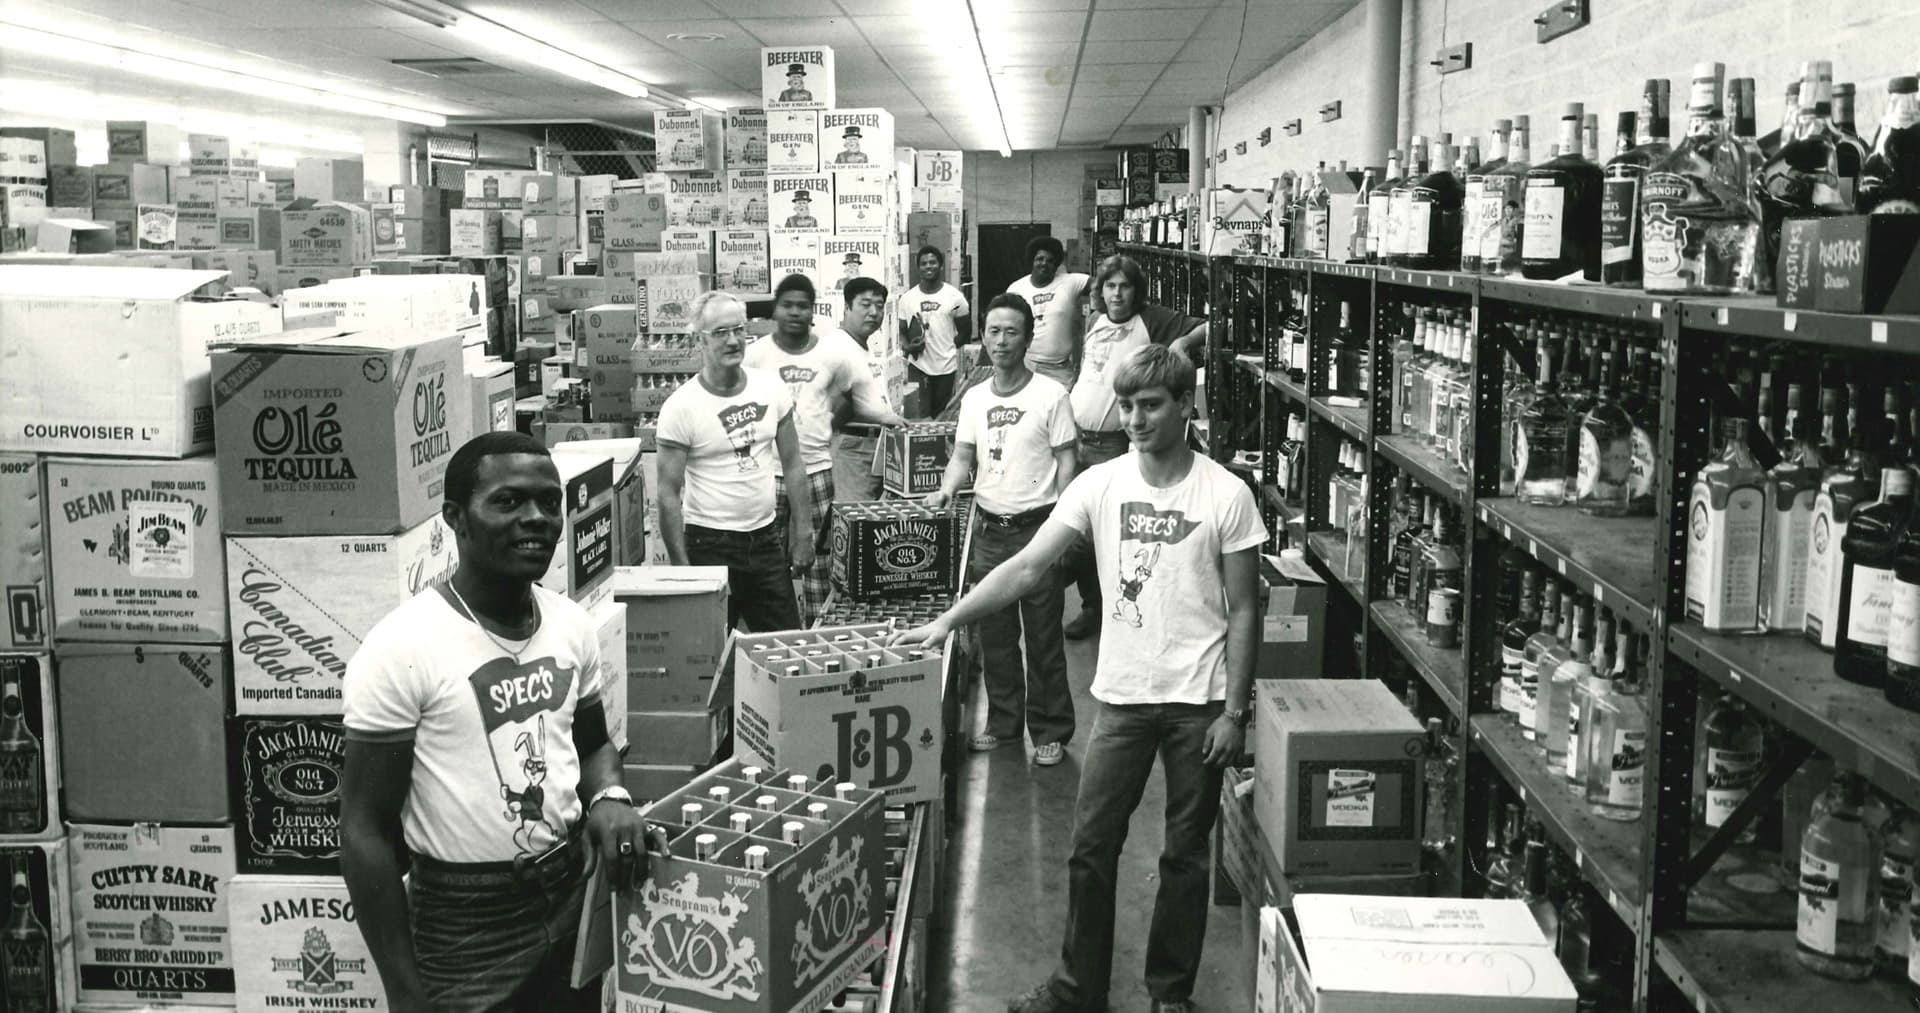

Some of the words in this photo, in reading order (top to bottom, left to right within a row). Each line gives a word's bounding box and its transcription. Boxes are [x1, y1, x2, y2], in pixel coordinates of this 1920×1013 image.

[768, 51, 824, 67] BEEFEATER
[660, 118, 700, 130] Dubonnet
[731, 116, 768, 128] Dubonne
[824, 114, 880, 130] BEEFEATER
[770, 133, 814, 144] BEEFEATER
[926, 161, 952, 182] J&B
[670, 179, 722, 194] Dubonnet
[732, 178, 768, 190] Dubonne
[773, 179, 829, 194] BEEFEATER
[839, 194, 882, 206] BEEFEATER
[1212, 215, 1264, 232] Bevnaps
[289, 240, 311, 248] SAFETY
[314, 240, 342, 248] MATCHES
[611, 238, 635, 248] GLASS
[666, 240, 706, 250] Dubonnet
[721, 240, 763, 252] Dubonnet
[824, 241, 880, 256] BEEFEATER
[773, 258, 817, 270] BEEFEATER
[611, 294, 634, 304] GLASS
[639, 286, 648, 328] GENUINO
[783, 368, 814, 382] SPEC'S
[263, 388, 343, 400] IMPORTED
[413, 372, 446, 438] Olé
[726, 404, 757, 428] SPEC'S
[990, 408, 1020, 424] SPEC'S
[24, 424, 134, 440] COURVOISIER
[253, 402, 344, 456] Olé
[410, 430, 452, 468] TEQUILA
[244, 458, 358, 482] TEQUILA
[60, 478, 68, 488] 12
[151, 480, 176, 490] ROUND
[177, 481, 206, 491] QUARTS
[913, 472, 938, 487] WILD
[263, 482, 296, 493] MADE
[298, 482, 312, 492] IN
[313, 482, 356, 493] MEXICO
[62, 490, 116, 523] BEAM
[137, 516, 157, 534] JIM
[158, 512, 186, 536] BEAM
[1128, 514, 1178, 536] SPEC'S
[576, 526, 596, 554] Johnnie
[594, 517, 612, 539] Walker
[874, 523, 899, 546] JACK
[899, 520, 939, 542] DANIEL'S
[341, 544, 350, 552] 12
[354, 544, 387, 552] QUARTS
[582, 548, 595, 566] BLACK
[595, 540, 608, 559] LABEL
[898, 548, 915, 557] Old
[896, 556, 917, 564] No.7
[874, 572, 908, 584] TENNESSEE
[910, 571, 938, 580] WHISKEY
[74, 588, 98, 597] JAMES
[113, 588, 136, 598] BEAM
[139, 588, 182, 598] DISTILLING
[186, 590, 200, 599] CO.
[12, 592, 38, 641] Q
[152, 610, 195, 618] KENTUCKY
[78, 622, 106, 631] Famous
[111, 622, 122, 632] for
[126, 622, 154, 632] Quality
[158, 622, 178, 632] Since
[196, 653, 212, 668] 12
[178, 652, 214, 688] QUARTS
[242, 686, 293, 702] Imported
[296, 686, 342, 700] Canadia
[490, 666, 554, 714] SPEC'S
[258, 730, 296, 760] JACK
[296, 723, 346, 755] DANIE
[816, 705, 913, 789] J&B
[286, 750, 304, 758] OLD
[310, 748, 330, 758] TIME
[296, 768, 320, 780] Old
[295, 780, 324, 791] No.7
[1332, 804, 1368, 812] VODKA
[272, 806, 340, 828] Tenness
[84, 832, 118, 841] PRODUCE
[270, 834, 341, 848] WHISK
[83, 842, 128, 852] SCOTLAND
[190, 844, 223, 854] QUARTS
[816, 856, 850, 887] Seagram's
[91, 864, 158, 890] CUTTY
[162, 865, 220, 895] SARK
[726, 875, 733, 884] 12
[734, 876, 760, 889] QUARTS
[93, 894, 150, 911] SCOTCH
[152, 896, 218, 913] WHISKY
[661, 893, 718, 916] Seagram's
[260, 897, 356, 926] JAMESO
[818, 893, 850, 942] VO
[95, 948, 132, 963] BERRY
[170, 950, 206, 964] RUDD
[661, 922, 718, 978] VO
[843, 944, 876, 980] CANADA
[114, 968, 206, 990] QUARTS
[266, 996, 305, 1008] IRISH
[310, 997, 377, 1009] WHISKEY
